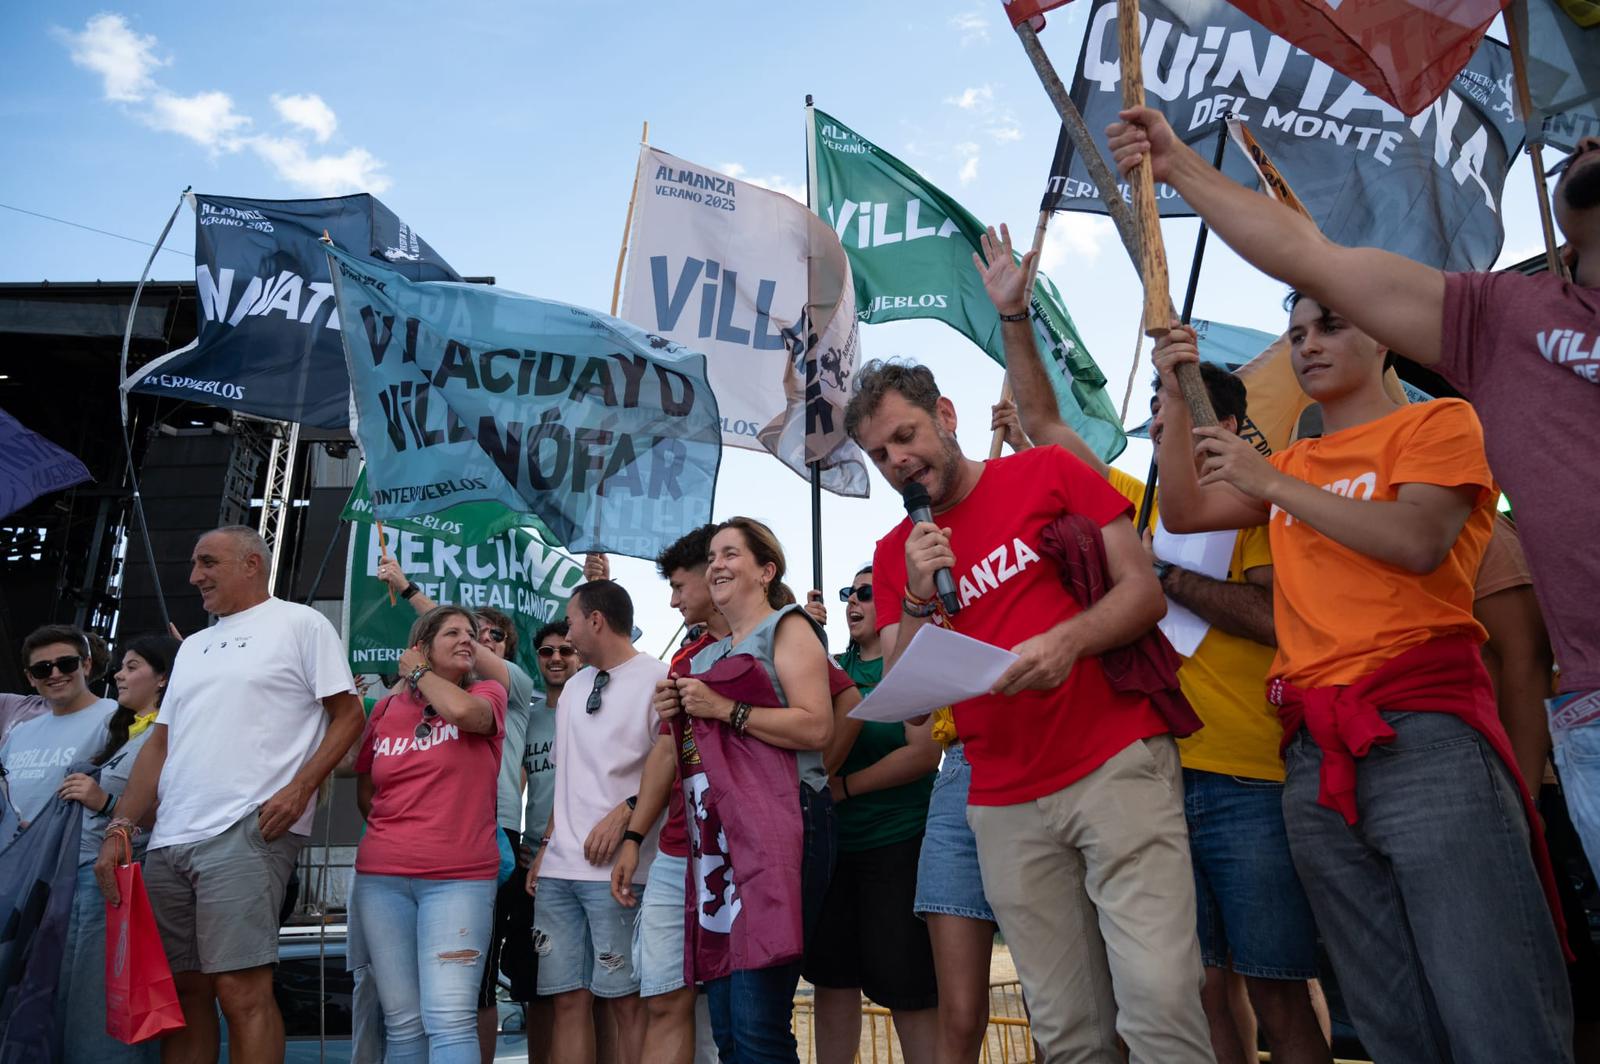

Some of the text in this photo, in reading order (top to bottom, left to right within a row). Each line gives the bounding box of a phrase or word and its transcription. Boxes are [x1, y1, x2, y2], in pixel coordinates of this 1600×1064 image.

[1187, 94, 1404, 167] DEL MONTE
[655, 165, 736, 198] ALMANZA
[655, 185, 736, 211] VERANO 2025
[200, 216, 244, 226] VERANO
[957, 537, 1041, 610] ANZA
[460, 582, 515, 610] REAL
